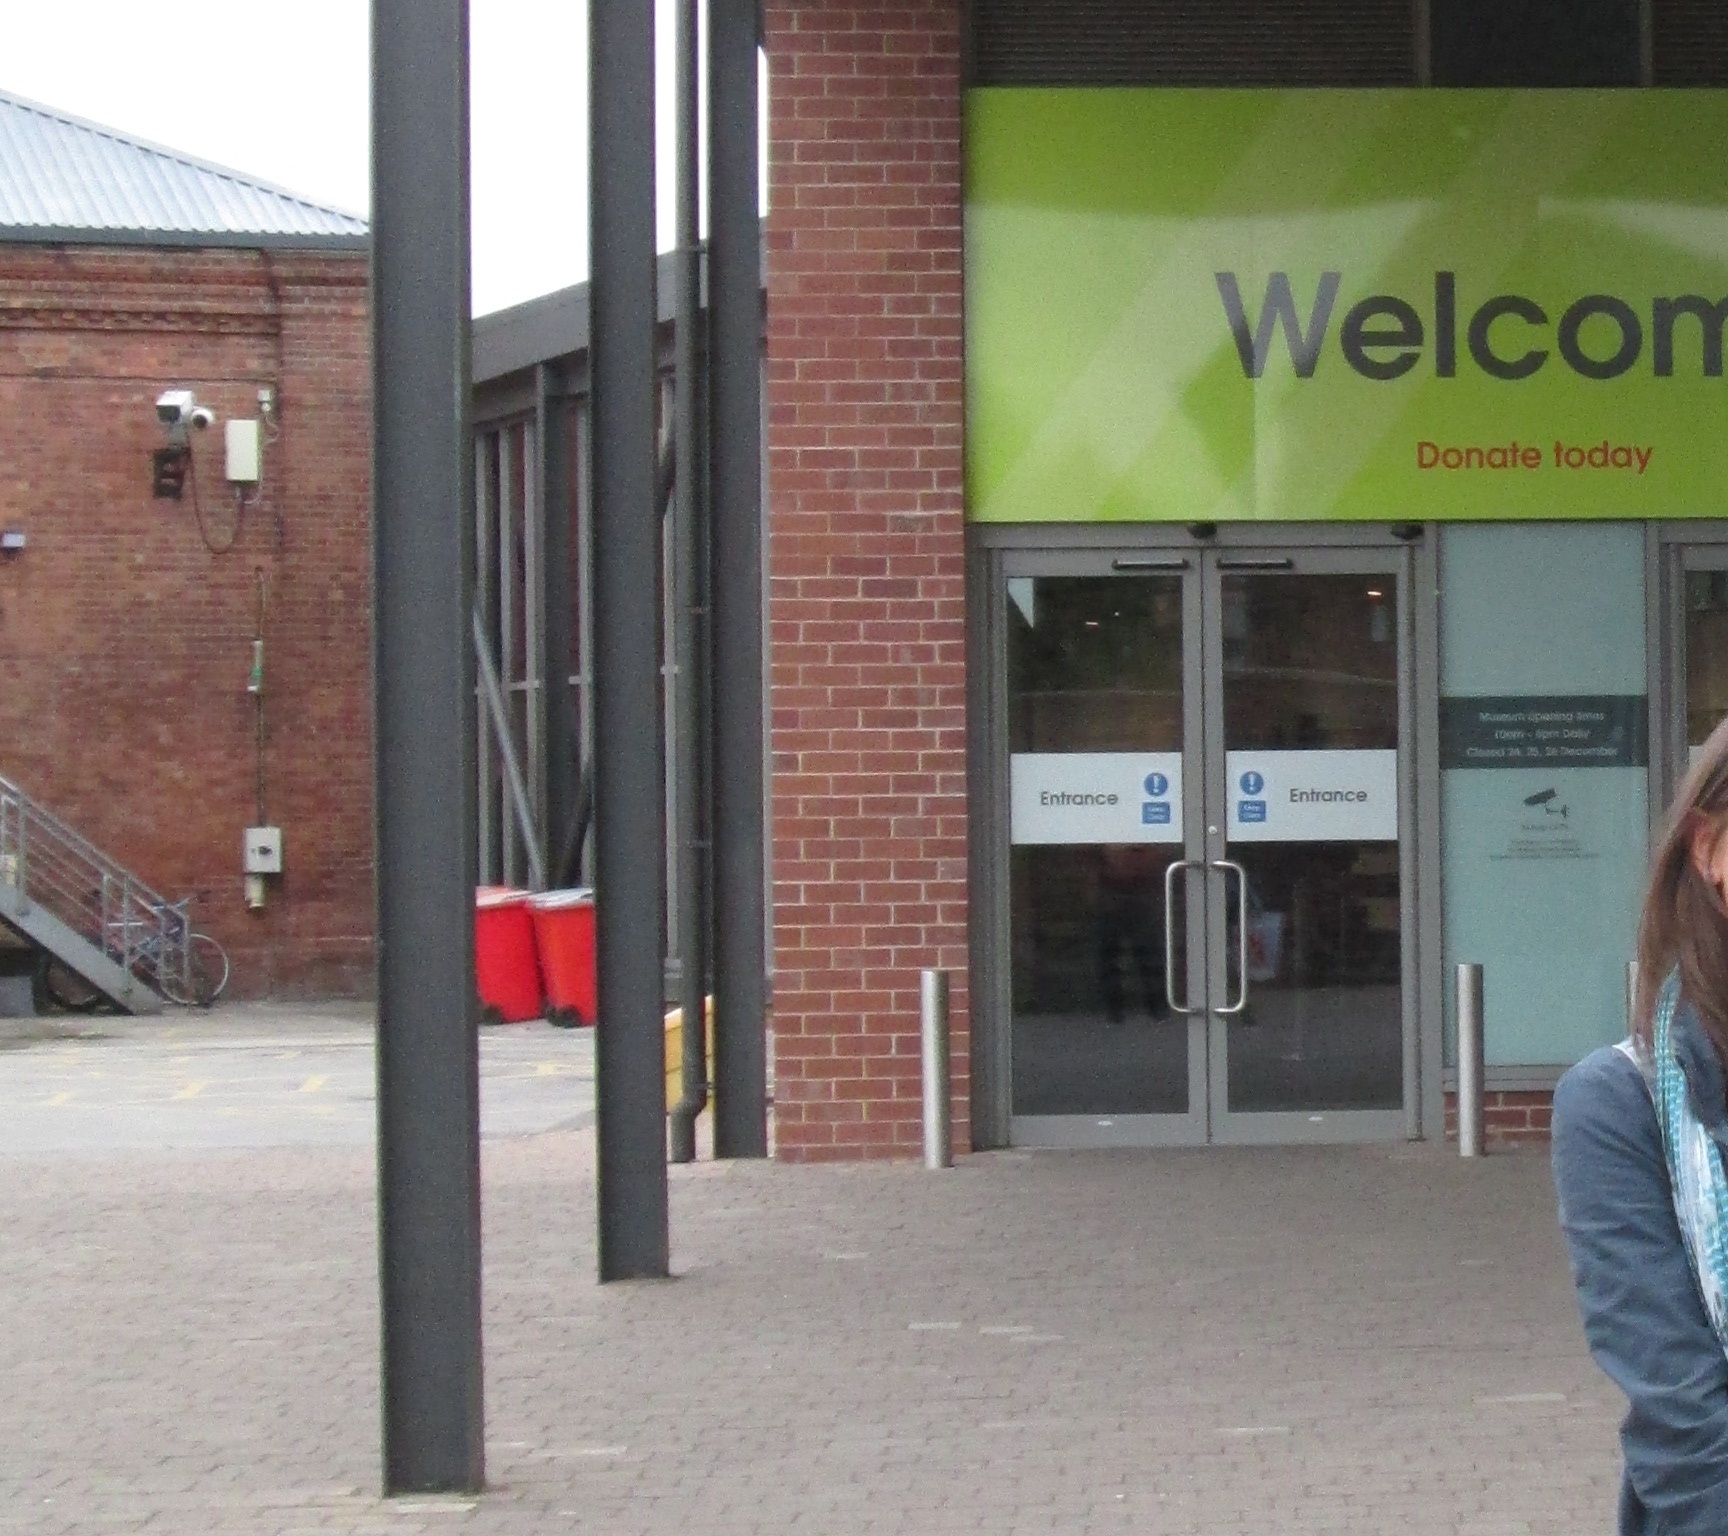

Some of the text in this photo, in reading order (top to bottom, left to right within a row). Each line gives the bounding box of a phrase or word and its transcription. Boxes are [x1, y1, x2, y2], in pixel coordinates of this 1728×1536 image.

[1417, 440, 1653, 475] Donate today
[1040, 791, 1119, 806] Entrance
[1289, 788, 1368, 803] Entrance
